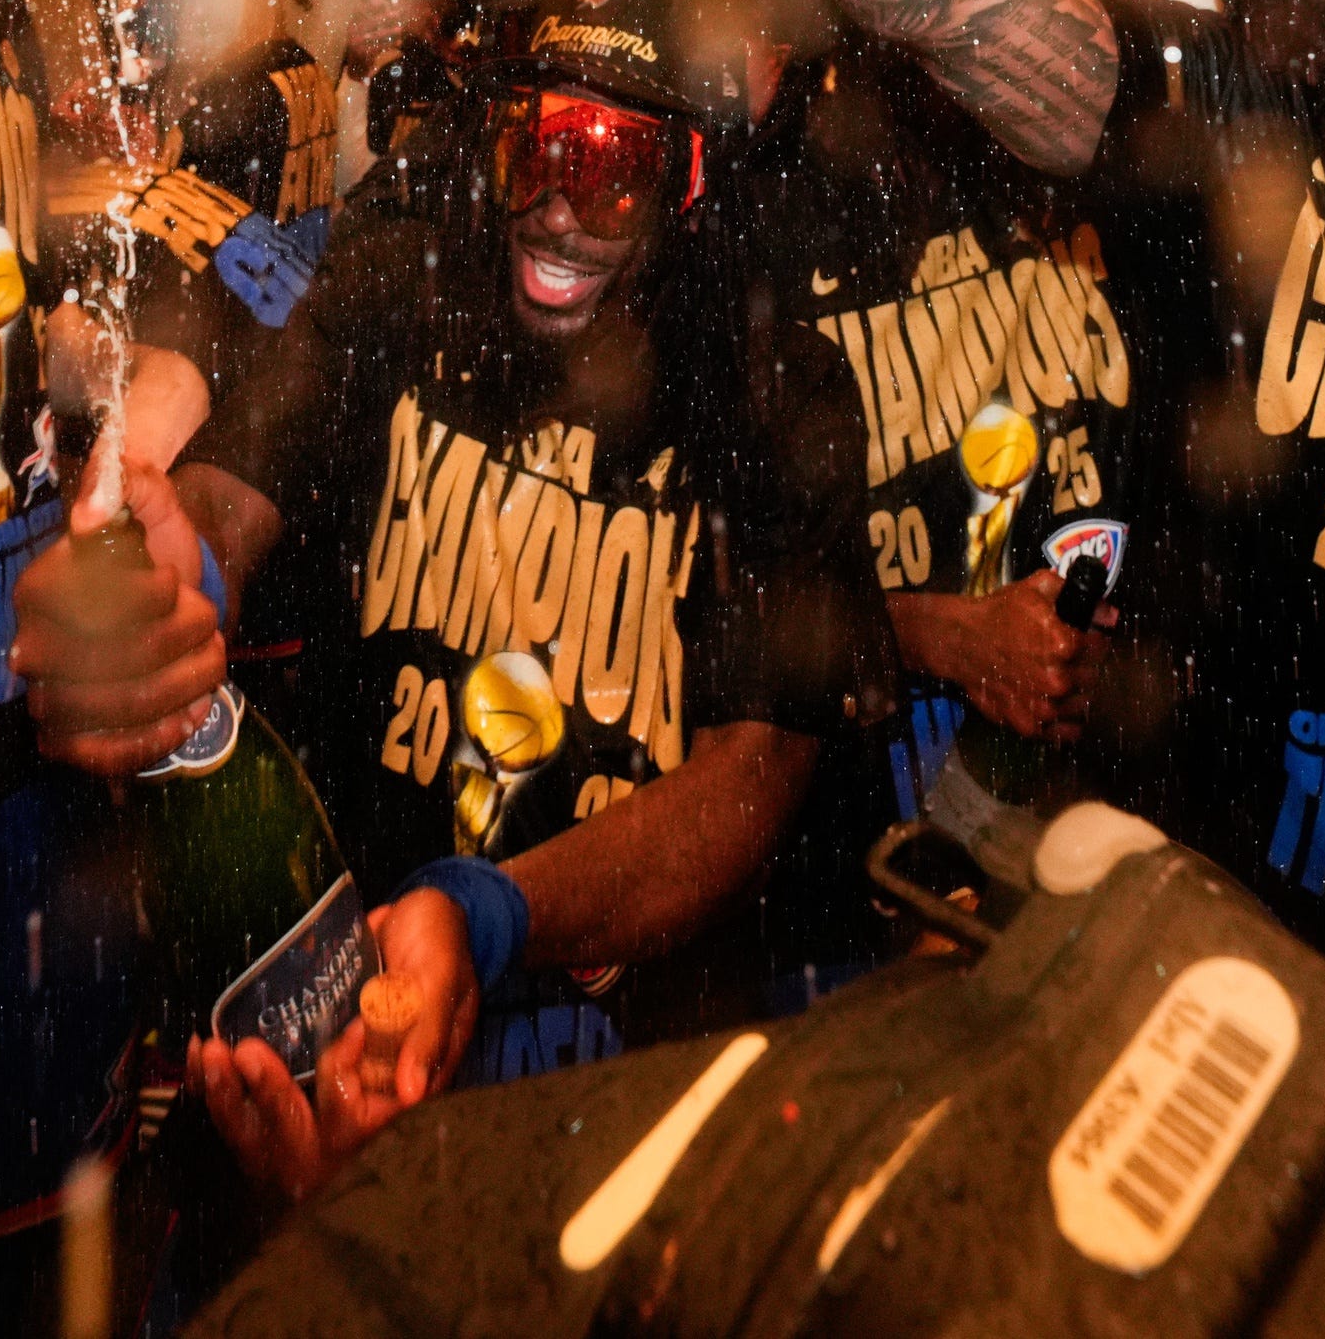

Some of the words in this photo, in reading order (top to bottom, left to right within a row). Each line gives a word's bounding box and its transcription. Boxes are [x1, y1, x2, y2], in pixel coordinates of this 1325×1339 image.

[530, 15, 658, 62] Champions
[1046, 426, 1102, 516] 25
[868, 505, 932, 590] 20
[381, 664, 451, 787] 20
